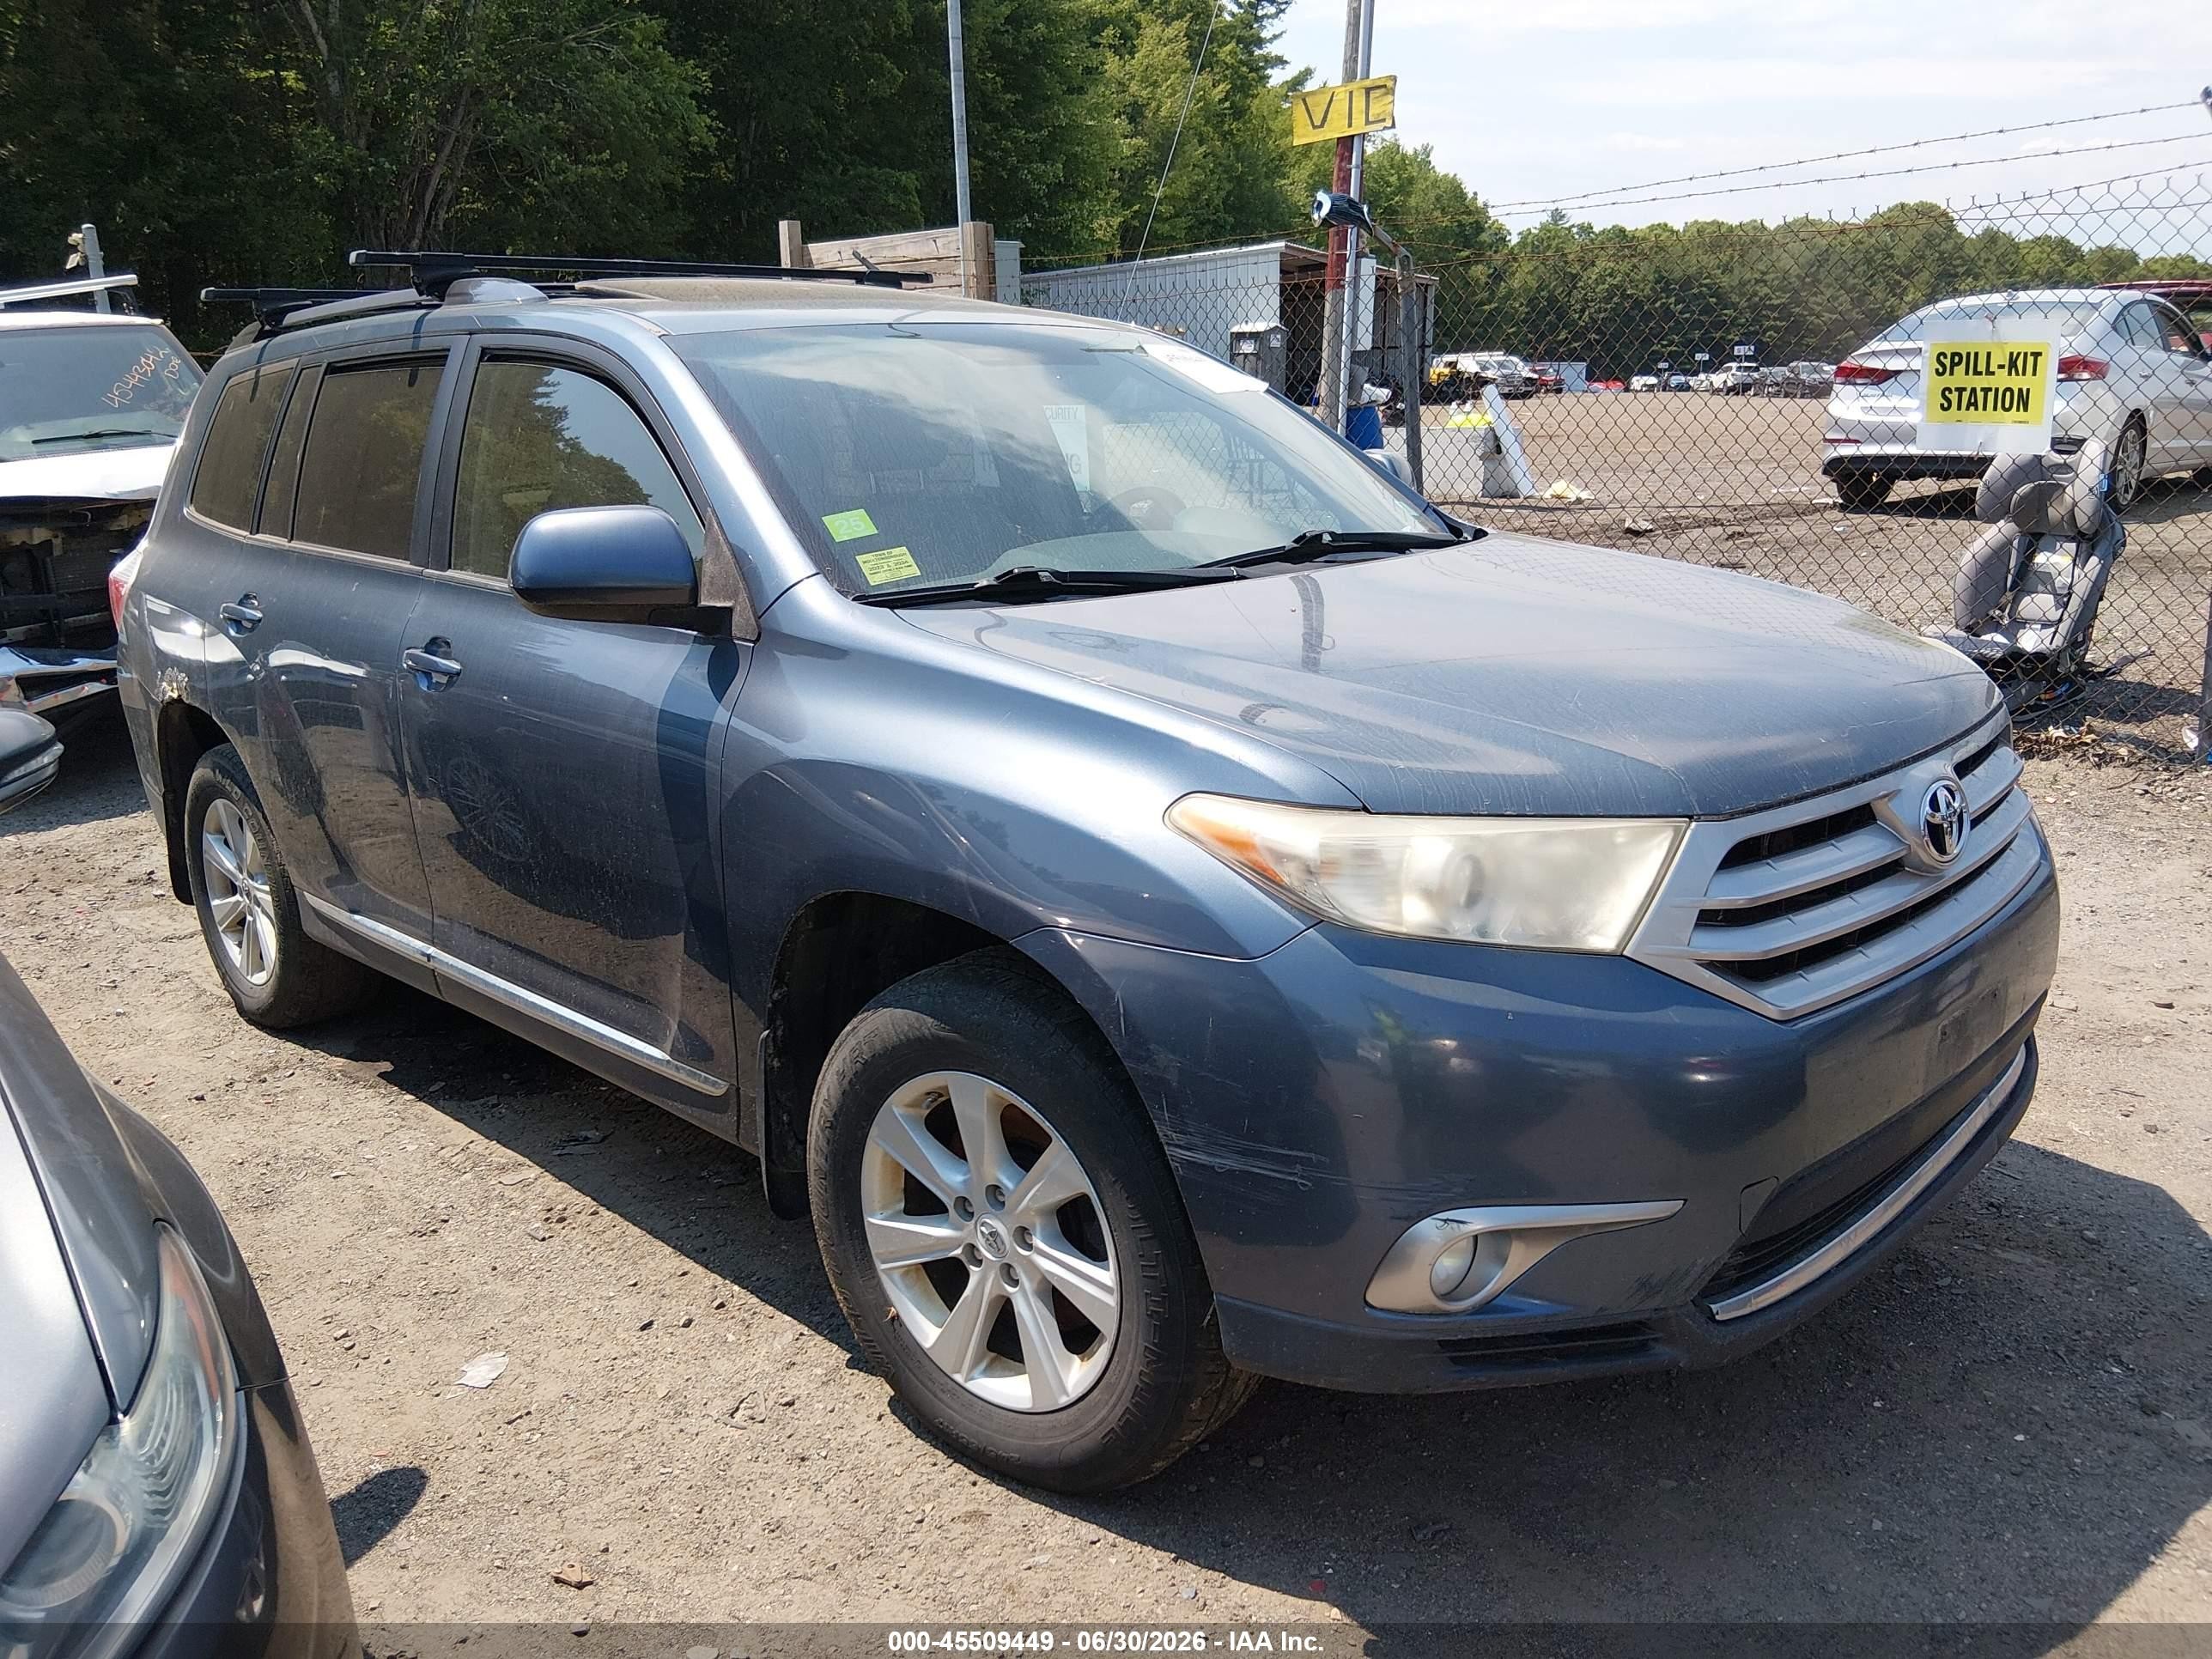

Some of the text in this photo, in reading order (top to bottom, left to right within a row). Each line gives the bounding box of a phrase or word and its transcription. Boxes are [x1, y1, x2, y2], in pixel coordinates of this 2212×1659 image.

[1935, 351, 2043, 377] SPILL-KIT
[1939, 386, 2031, 412] STATION
[835, 519, 866, 534] 25
[1100, 1176, 1169, 1444] ULTI-MILE
